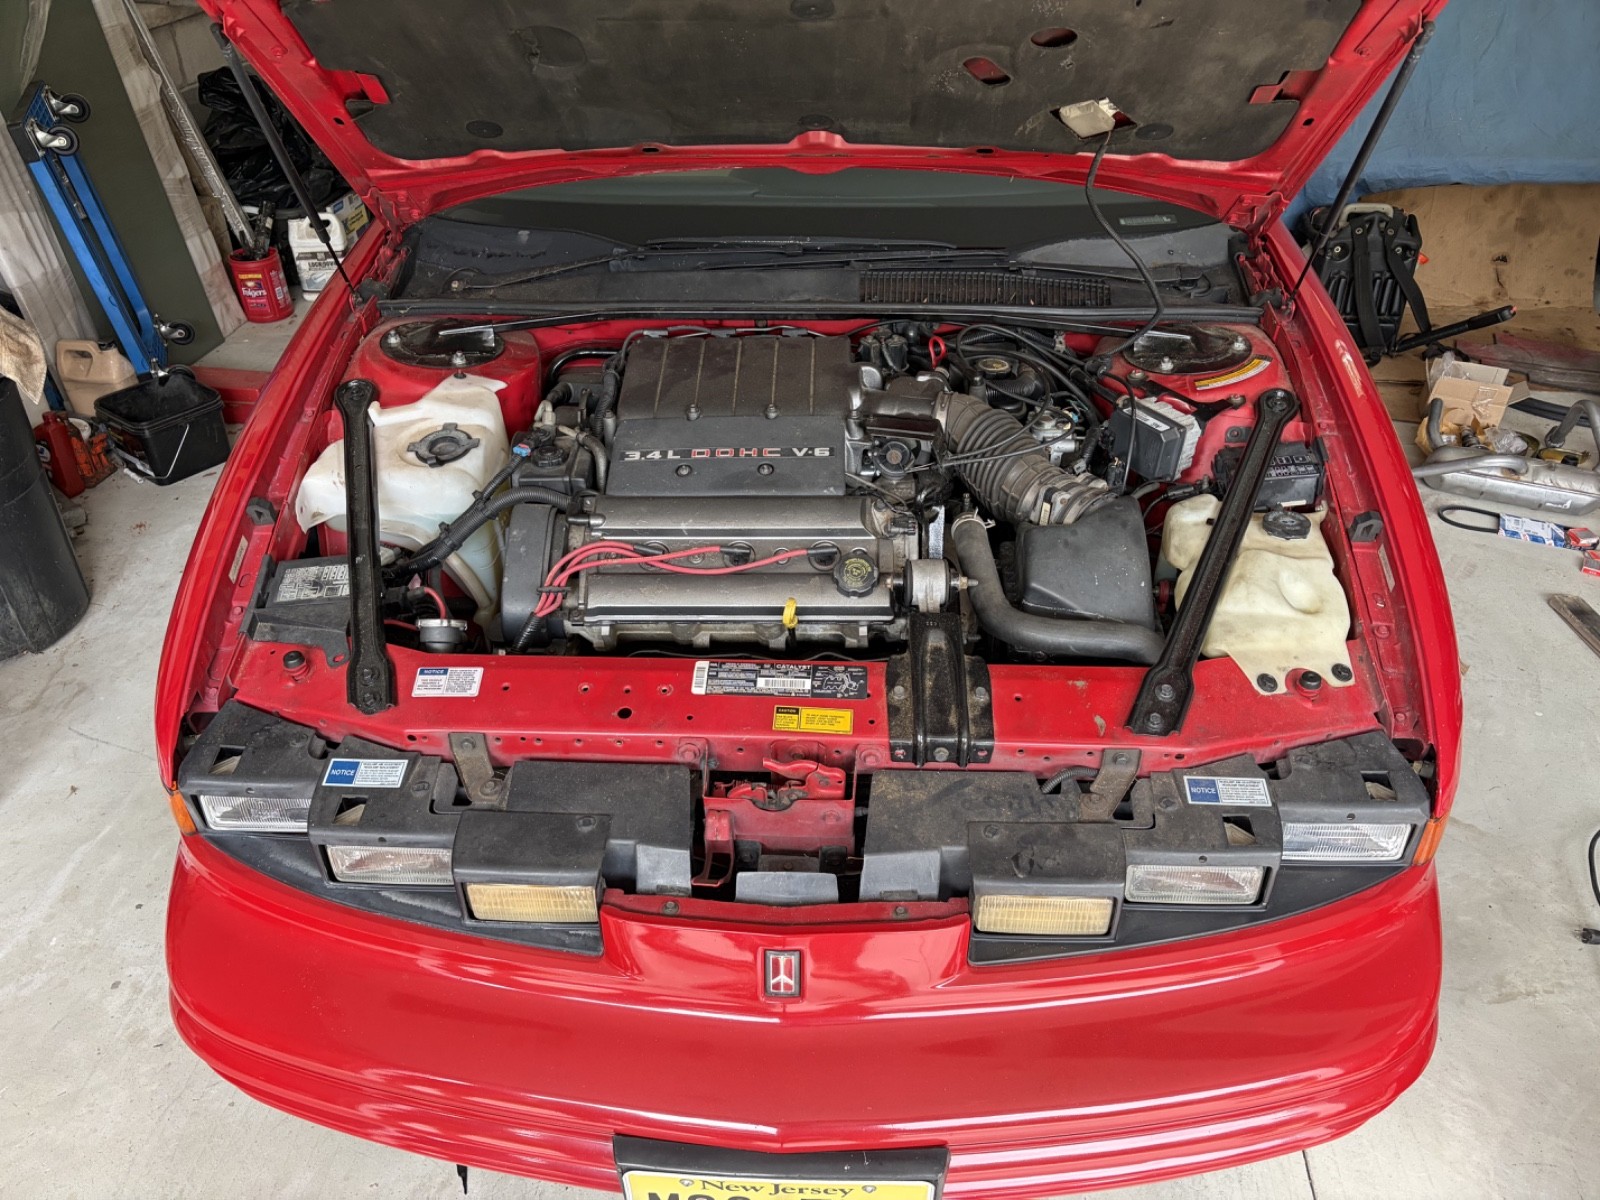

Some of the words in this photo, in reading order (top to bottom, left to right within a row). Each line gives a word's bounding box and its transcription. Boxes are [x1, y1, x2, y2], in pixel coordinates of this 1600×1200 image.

[242, 287, 267, 298] Folgers
[691, 447, 781, 458] DOHC
[699, 1180, 765, 1192] New
[768, 1183, 855, 1196] Jersey
